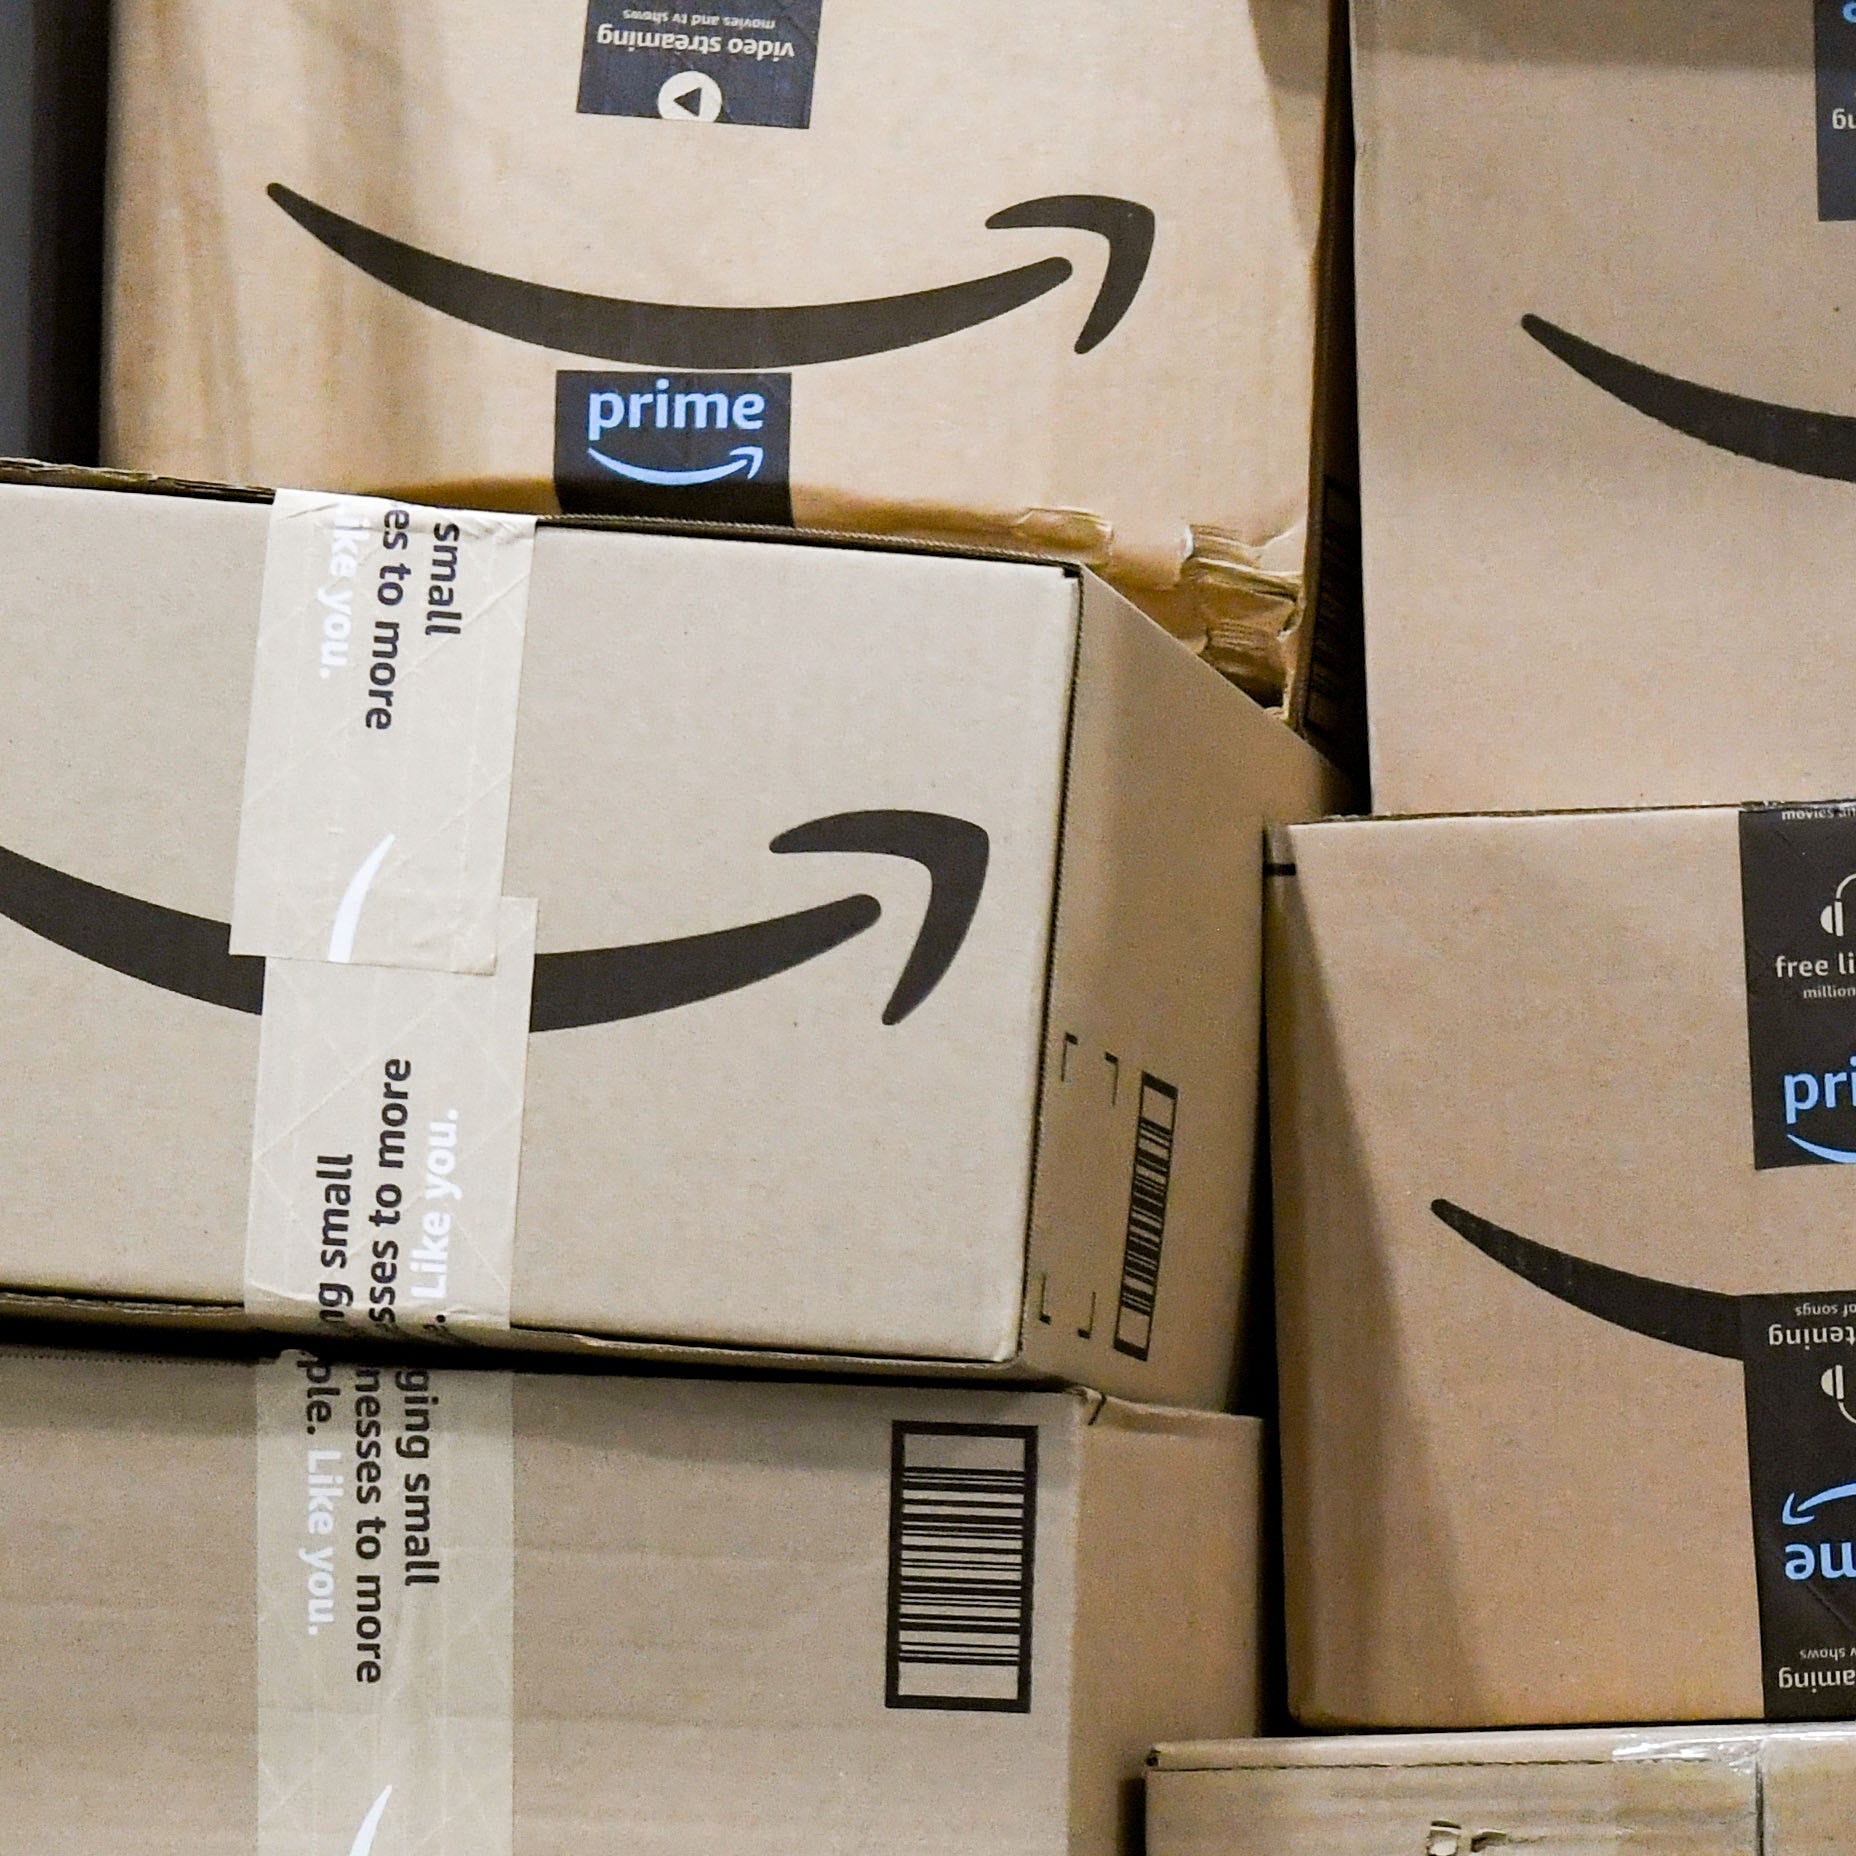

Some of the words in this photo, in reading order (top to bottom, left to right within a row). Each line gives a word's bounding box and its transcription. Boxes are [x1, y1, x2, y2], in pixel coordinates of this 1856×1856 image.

[596, 24, 722, 53] streaming
[727, 38, 796, 62] video
[587, 378, 765, 441] prime
[377, 562, 412, 606] to
[426, 522, 462, 636] small
[316, 585, 354, 680] you.
[365, 620, 400, 730] more
[1775, 955, 1829, 978] free
[378, 1058, 412, 1169] more
[425, 1108, 463, 1201] you.
[316, 1154, 354, 1268] small
[369, 1183, 402, 1225] to
[410, 1211, 452, 1299] Like
[1796, 1302, 1838, 1316] songs
[307, 1449, 343, 1536] Like
[405, 1473, 440, 1587] small
[356, 1517, 387, 1560] to
[299, 1547, 334, 1636] you.
[356, 1575, 382, 1684] more
